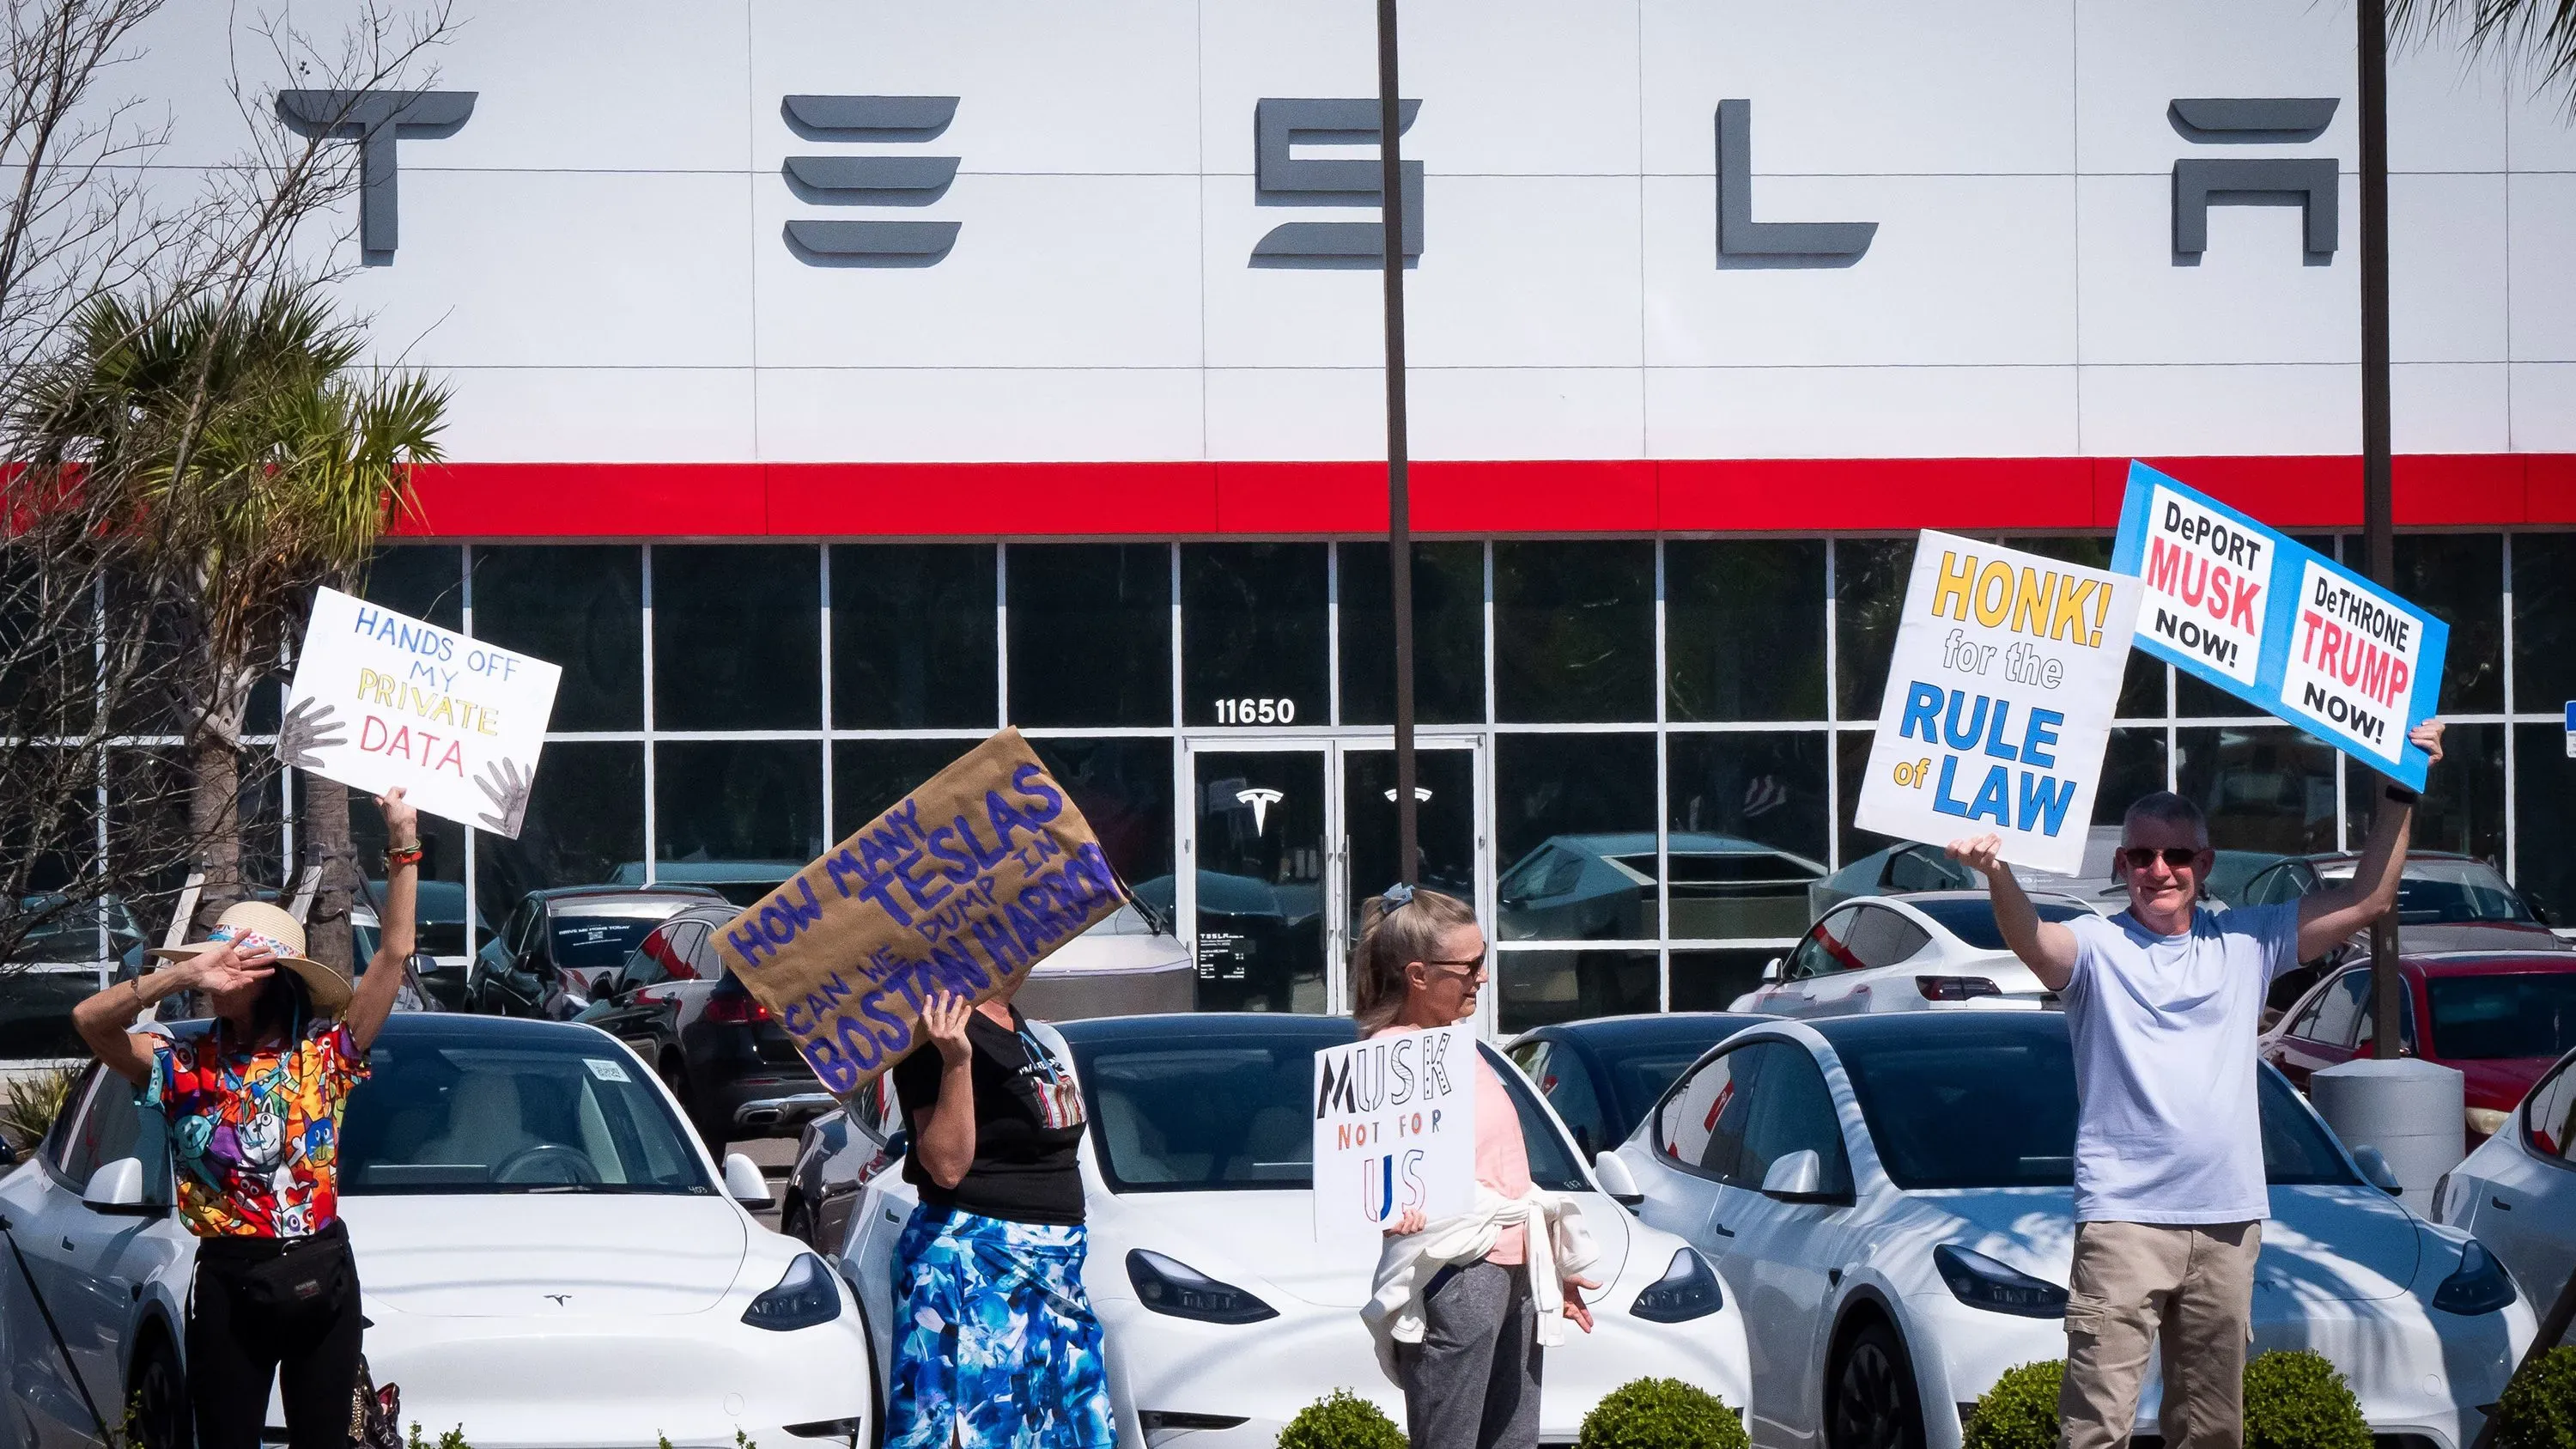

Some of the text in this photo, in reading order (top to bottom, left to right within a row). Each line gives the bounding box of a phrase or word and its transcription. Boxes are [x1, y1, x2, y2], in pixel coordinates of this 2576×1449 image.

[276, 90, 2341, 268] TESLA
[2164, 500, 2261, 571] DePORT
[1932, 551, 2114, 649] HONK!
[2147, 535, 2262, 637] MUSK
[2314, 576, 2409, 653] DeTHRONE
[355, 606, 521, 682] HANDS OFF
[1943, 629, 2063, 689] for the
[2155, 607, 2238, 668] NOW!
[2302, 609, 2409, 709] TRUMP
[357, 667, 499, 737] PRIVATE
[410, 661, 459, 692] MY
[1215, 698, 1295, 724] 11650
[2303, 681, 2385, 745] NOW!
[360, 715, 464, 777] DATA
[1899, 680, 2064, 769] RULE
[1893, 754, 2077, 837] of LAW
[728, 763, 1063, 969] HOW MANY TESLAS
[785, 828, 1061, 1037] CAN WE DUMP IN
[1316, 1032, 1452, 1119] MUSK
[1338, 1109, 1442, 1150] NOT FOR
[1364, 1149, 1425, 1222] US
